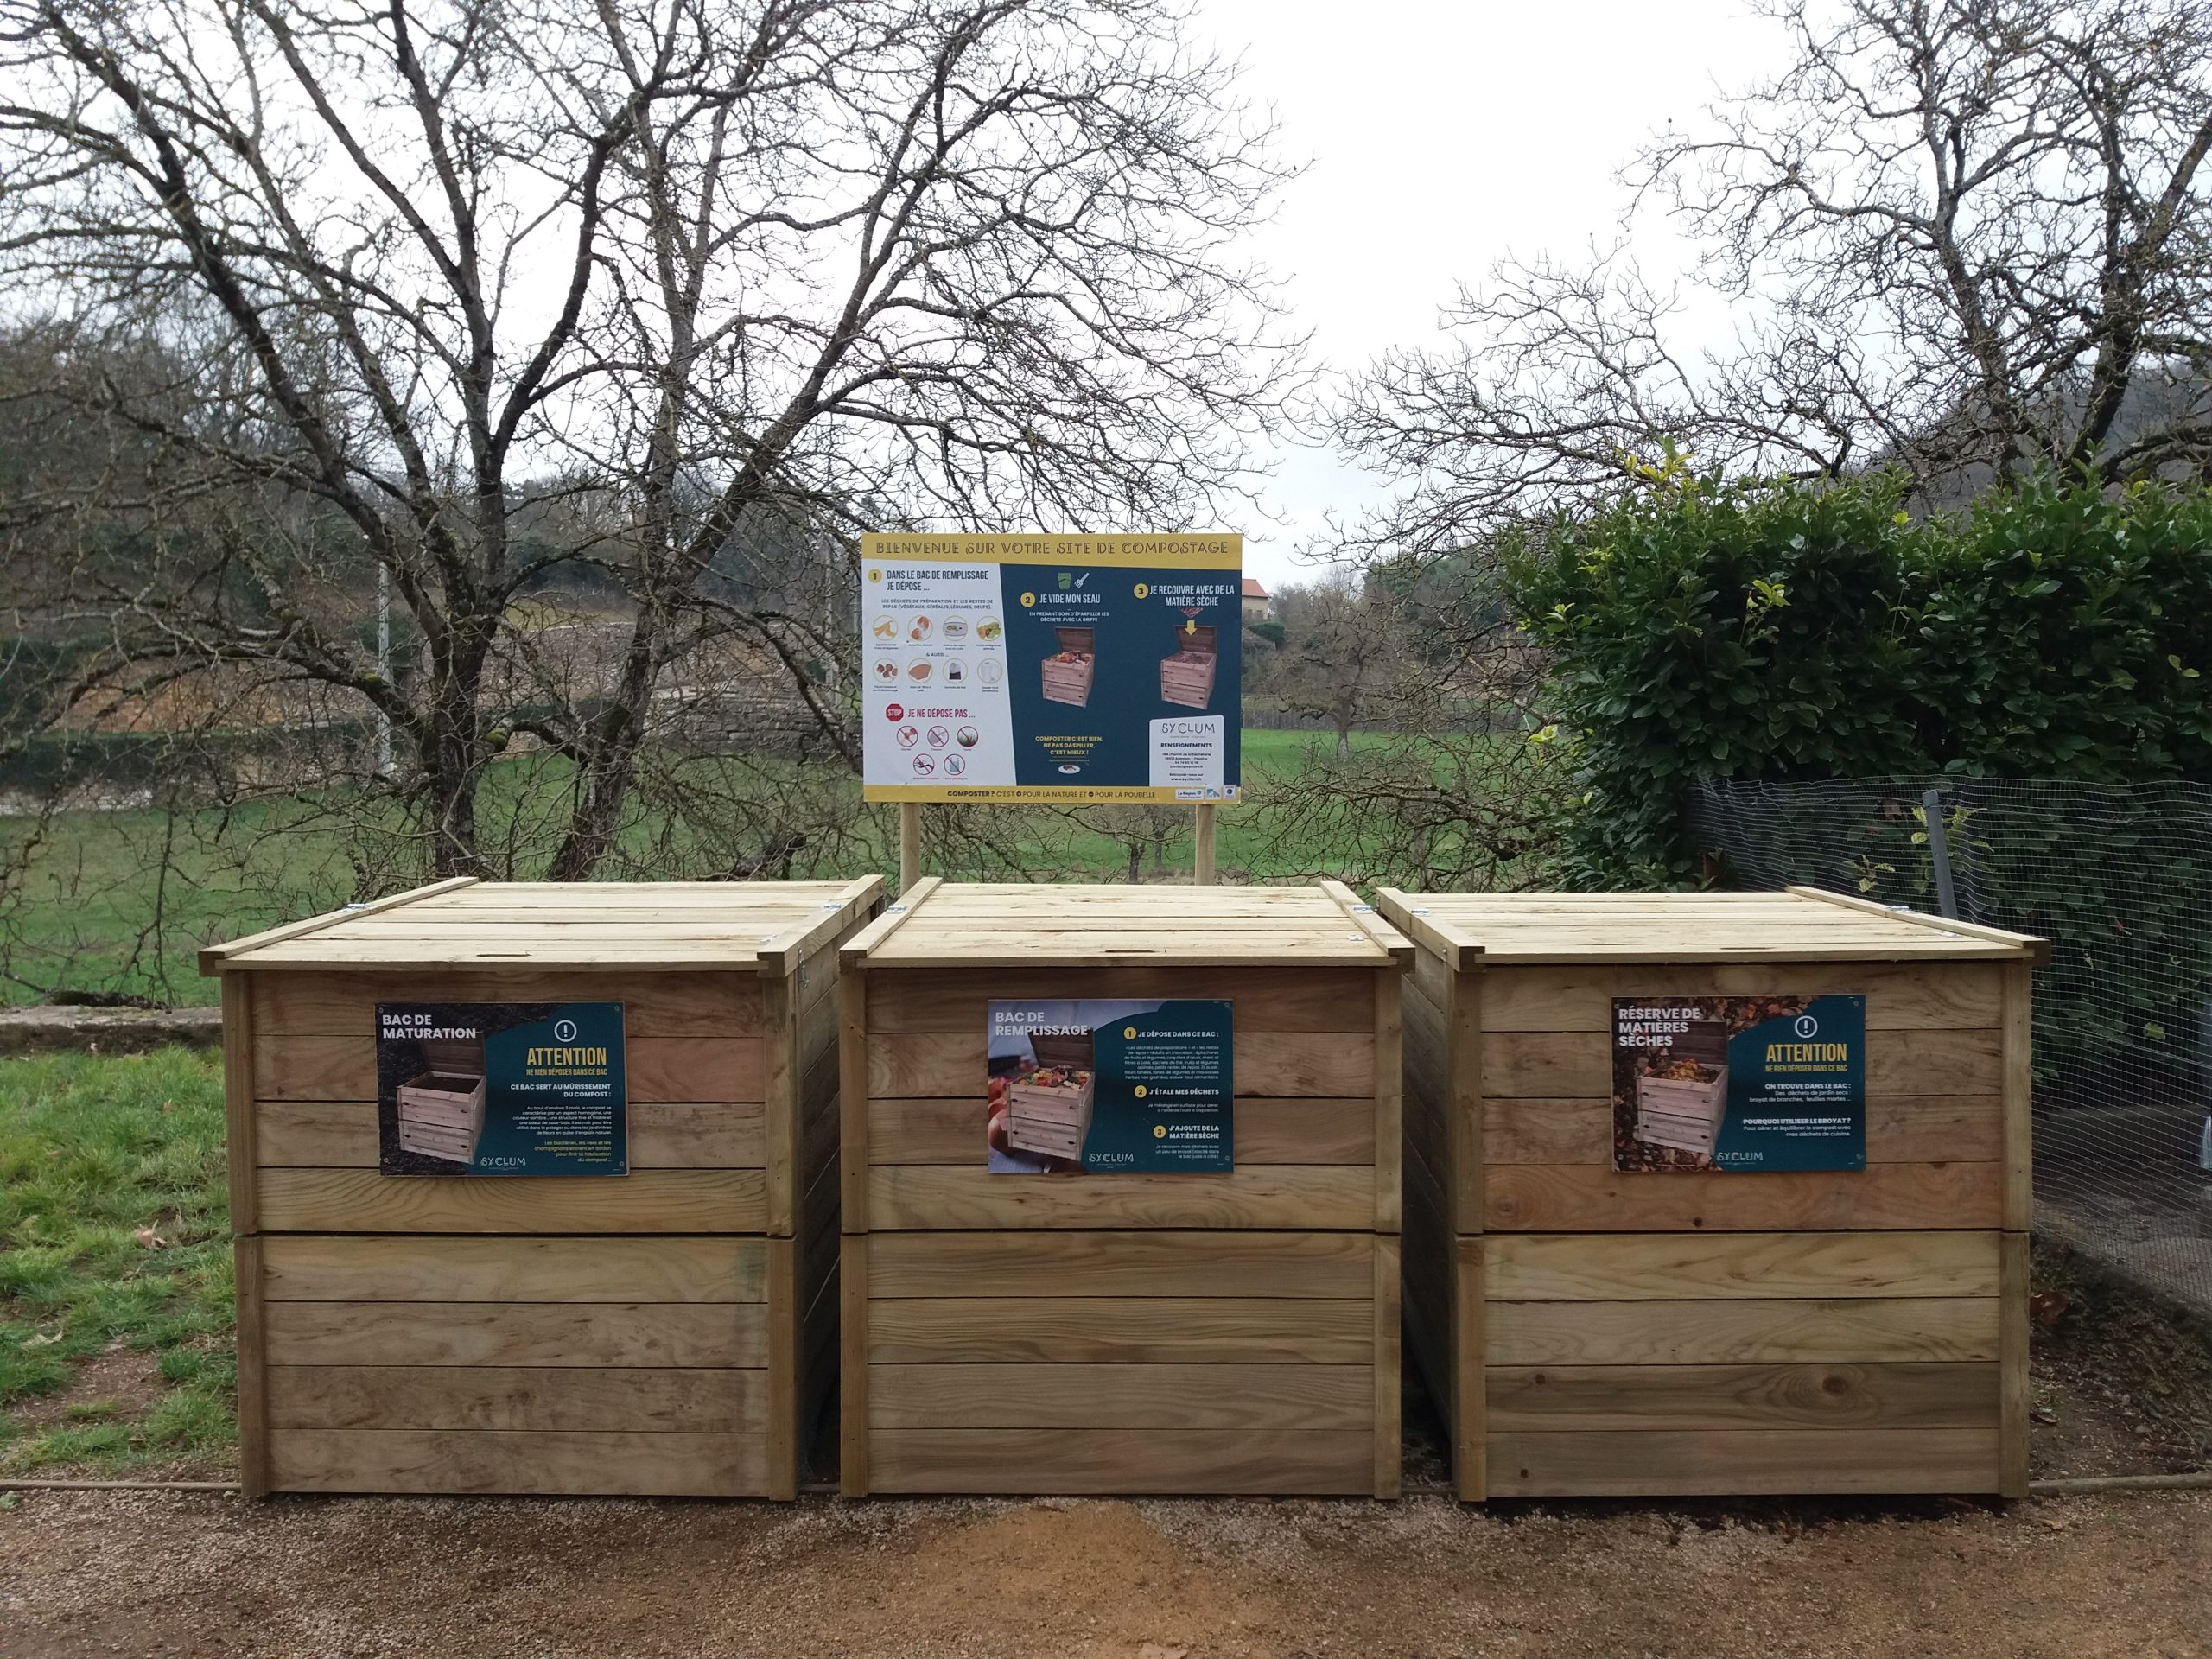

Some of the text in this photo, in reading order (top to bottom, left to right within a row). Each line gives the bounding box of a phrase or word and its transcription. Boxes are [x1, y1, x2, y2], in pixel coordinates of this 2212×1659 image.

[877, 542, 1227, 554] BIENVENUE SUR VOTRE SITE DE COMPOSTAGE
[887, 571, 905, 579] DANS
[907, 571, 914, 579] LE
[917, 571, 930, 579] BAC
[932, 571, 940, 579] DE
[942, 571, 988, 580] REMPLISSAGE
[887, 581, 921, 591] JE DÉPOSE
[1150, 586, 1157, 595] JE
[1159, 586, 1194, 594] RECOUVRE
[1196, 585, 1213, 594] AVEC
[1215, 585, 1224, 594] DE
[1226, 585, 1234, 594] LA
[1040, 594, 1047, 603] JE
[1049, 594, 1064, 603] VIDE
[1066, 594, 1080, 603] MON
[1082, 594, 1100, 603] SEAU
[1165, 595, 1218, 606] MATIÈRE SÈCHE
[908, 709, 914, 718] JE
[917, 709, 926, 718] NE
[928, 707, 952, 718] DÉPOSE
[955, 709, 967, 718] PAS
[1162, 723, 1215, 733] SYCLUM
[996, 1012, 1044, 1022] BAC DE
[1619, 1005, 1700, 1019] RÉSERVE DE
[382, 1014, 432, 1025] BAC DE
[996, 1025, 1088, 1036] REMPLISSAGE
[1619, 1019, 1688, 1033] MATIÈRES
[383, 1028, 476, 1039] MATURATION
[1619, 1033, 1673, 1047] SÈCHES
[527, 1047, 607, 1065] ATTENTION
[1766, 1044, 1847, 1062] ATTENTION
[480, 1157, 526, 1166] SYCLUM
[1089, 1153, 1134, 1163] SYCLUM
[1716, 1152, 1763, 1161] SYCLUM
